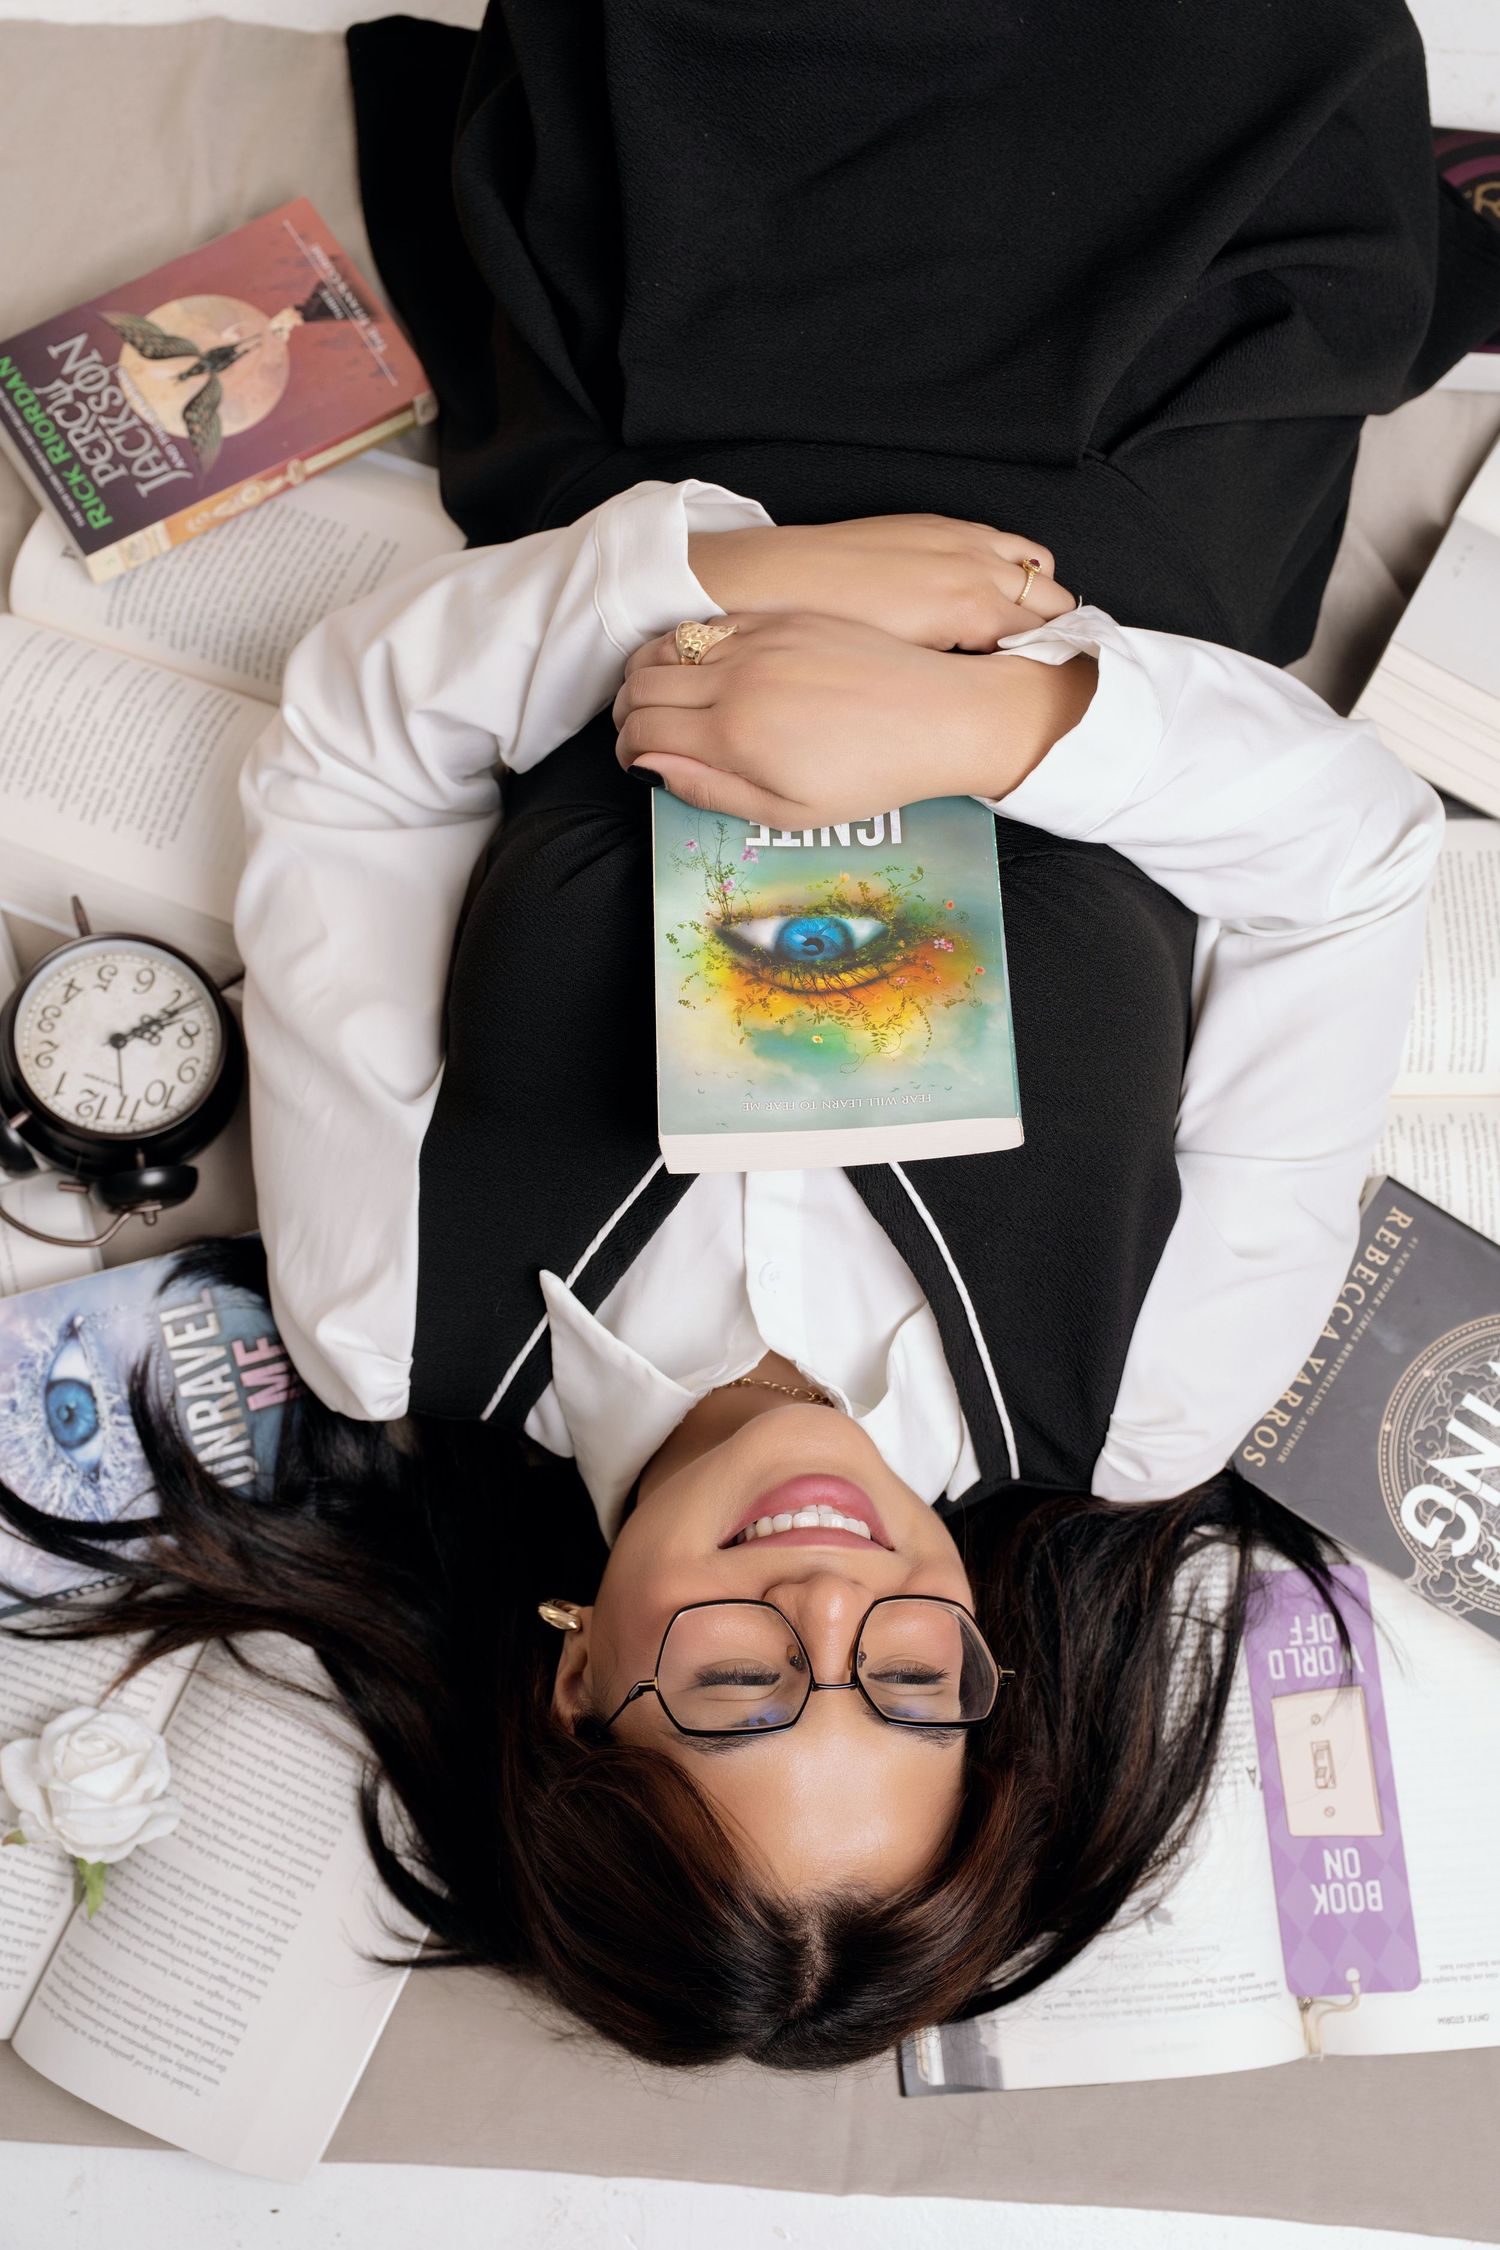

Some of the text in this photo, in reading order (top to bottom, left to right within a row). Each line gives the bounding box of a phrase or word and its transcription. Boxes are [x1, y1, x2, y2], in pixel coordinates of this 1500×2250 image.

[46, 331, 193, 497] JACKSON
[0, 355, 113, 531] RICK RIORDAN
[38, 383, 129, 488] PERCY
[62, 977, 85, 1006] 4
[95, 963, 119, 993] 5
[132, 967, 157, 995] 6
[37, 1004, 62, 1033] 3
[177, 1020, 201, 1050] 8
[35, 1041, 59, 1069] 2
[177, 1056, 201, 1083] 9
[53, 1071, 68, 1096] 1
[144, 1079, 177, 1109] 10
[76, 1089, 108, 1121] 12
[113, 1094, 142, 1125] 11
[742, 1093, 931, 1111] FEAR WILL LEARN TO FEAR ME
[1391, 1249, 1410, 1275] NEW
[1372, 1275, 1395, 1306] YORK
[1240, 1205, 1414, 1467] REBECCA YARROS
[1350, 1307, 1375, 1342] TIMES
[159, 1287, 259, 1489] UNRAVEL
[1304, 1342, 1353, 1416] BESTSELLING
[1275, 1415, 1308, 1464] AUTHOR
[1400, 1361, 1500, 1557] ING
[1286, 1611, 1338, 1646] OFF
[1267, 1642, 1364, 1680] WORLD
[1322, 1846, 1362, 1880] ON
[1310, 1878, 1384, 1915] BOOK
